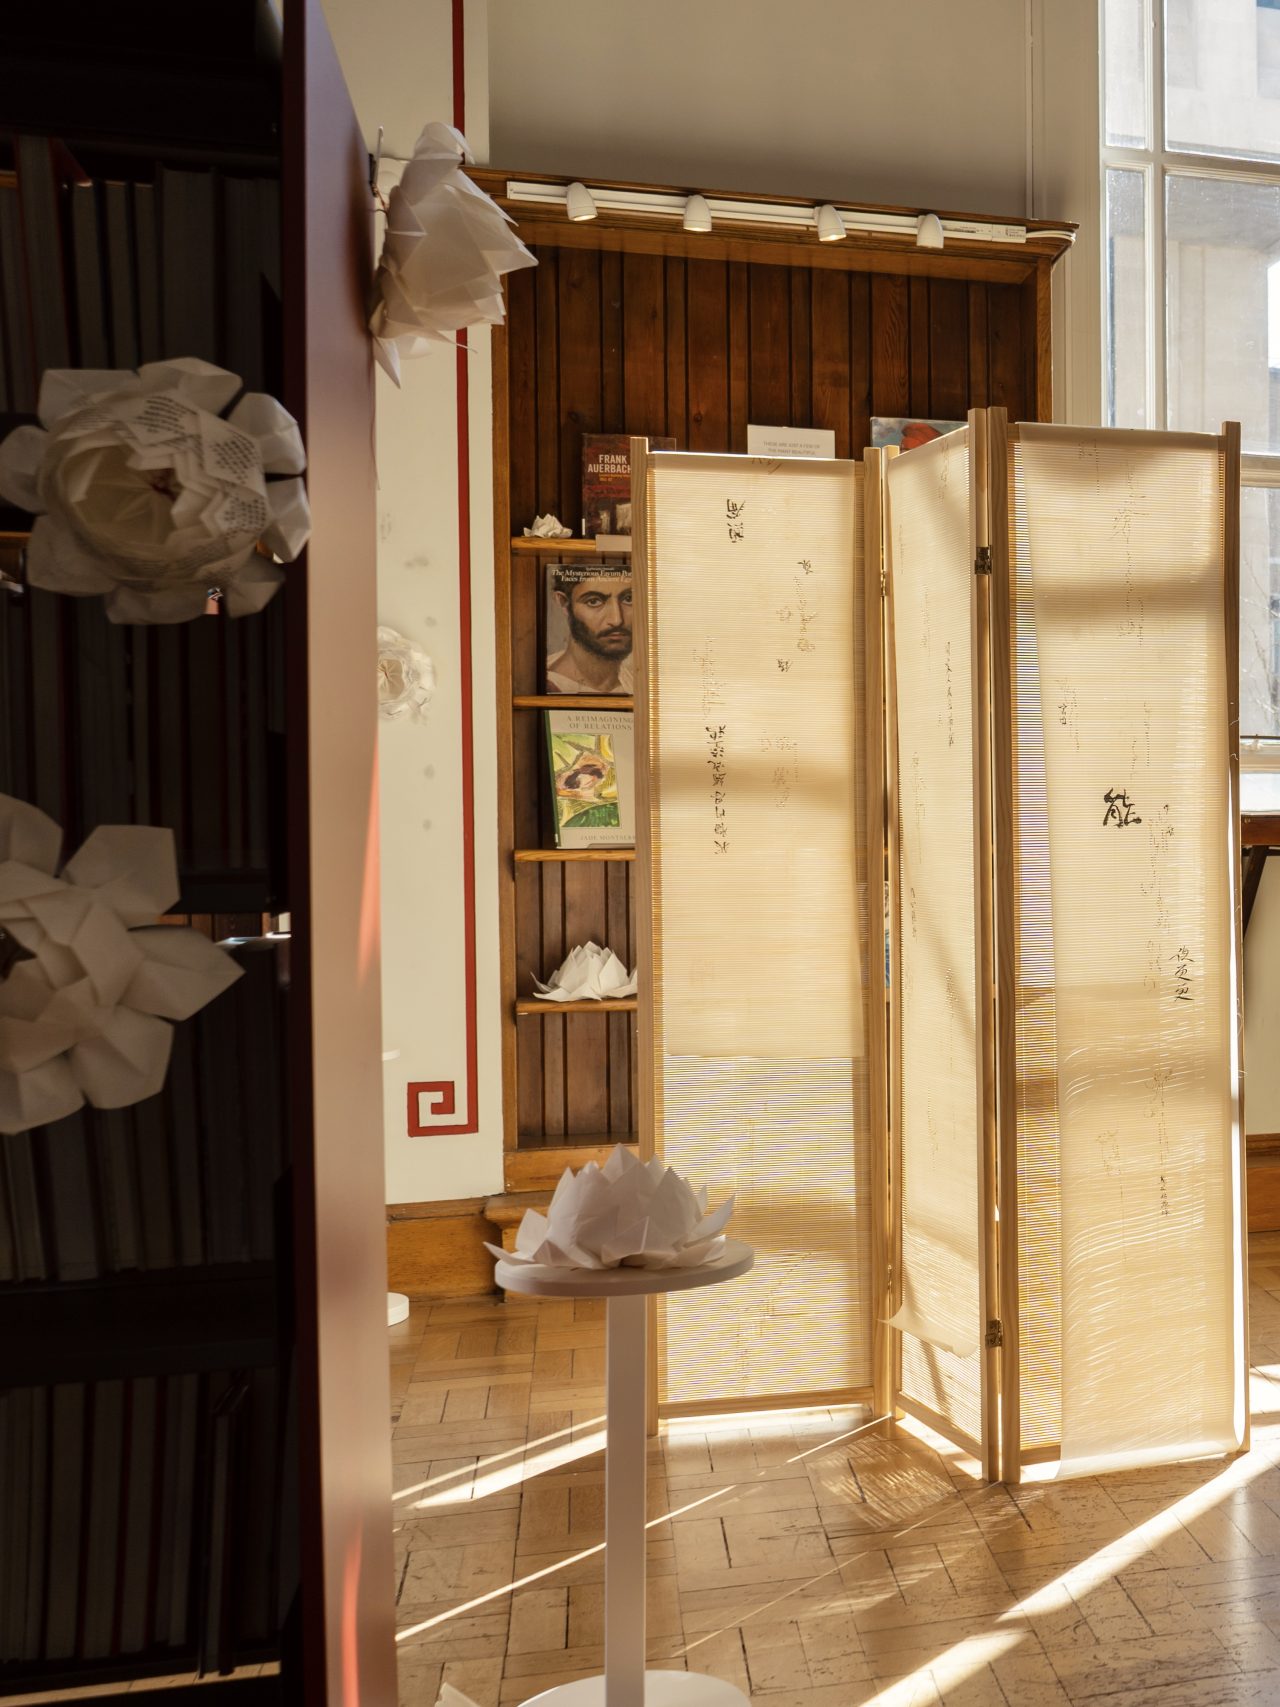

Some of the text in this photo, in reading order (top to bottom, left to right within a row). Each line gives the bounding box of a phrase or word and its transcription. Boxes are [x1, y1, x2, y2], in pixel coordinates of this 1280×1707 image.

[598, 454, 628, 465] FRANK
[564, 569, 599, 577] Mysterious
[584, 723, 632, 731] RELATIONS
